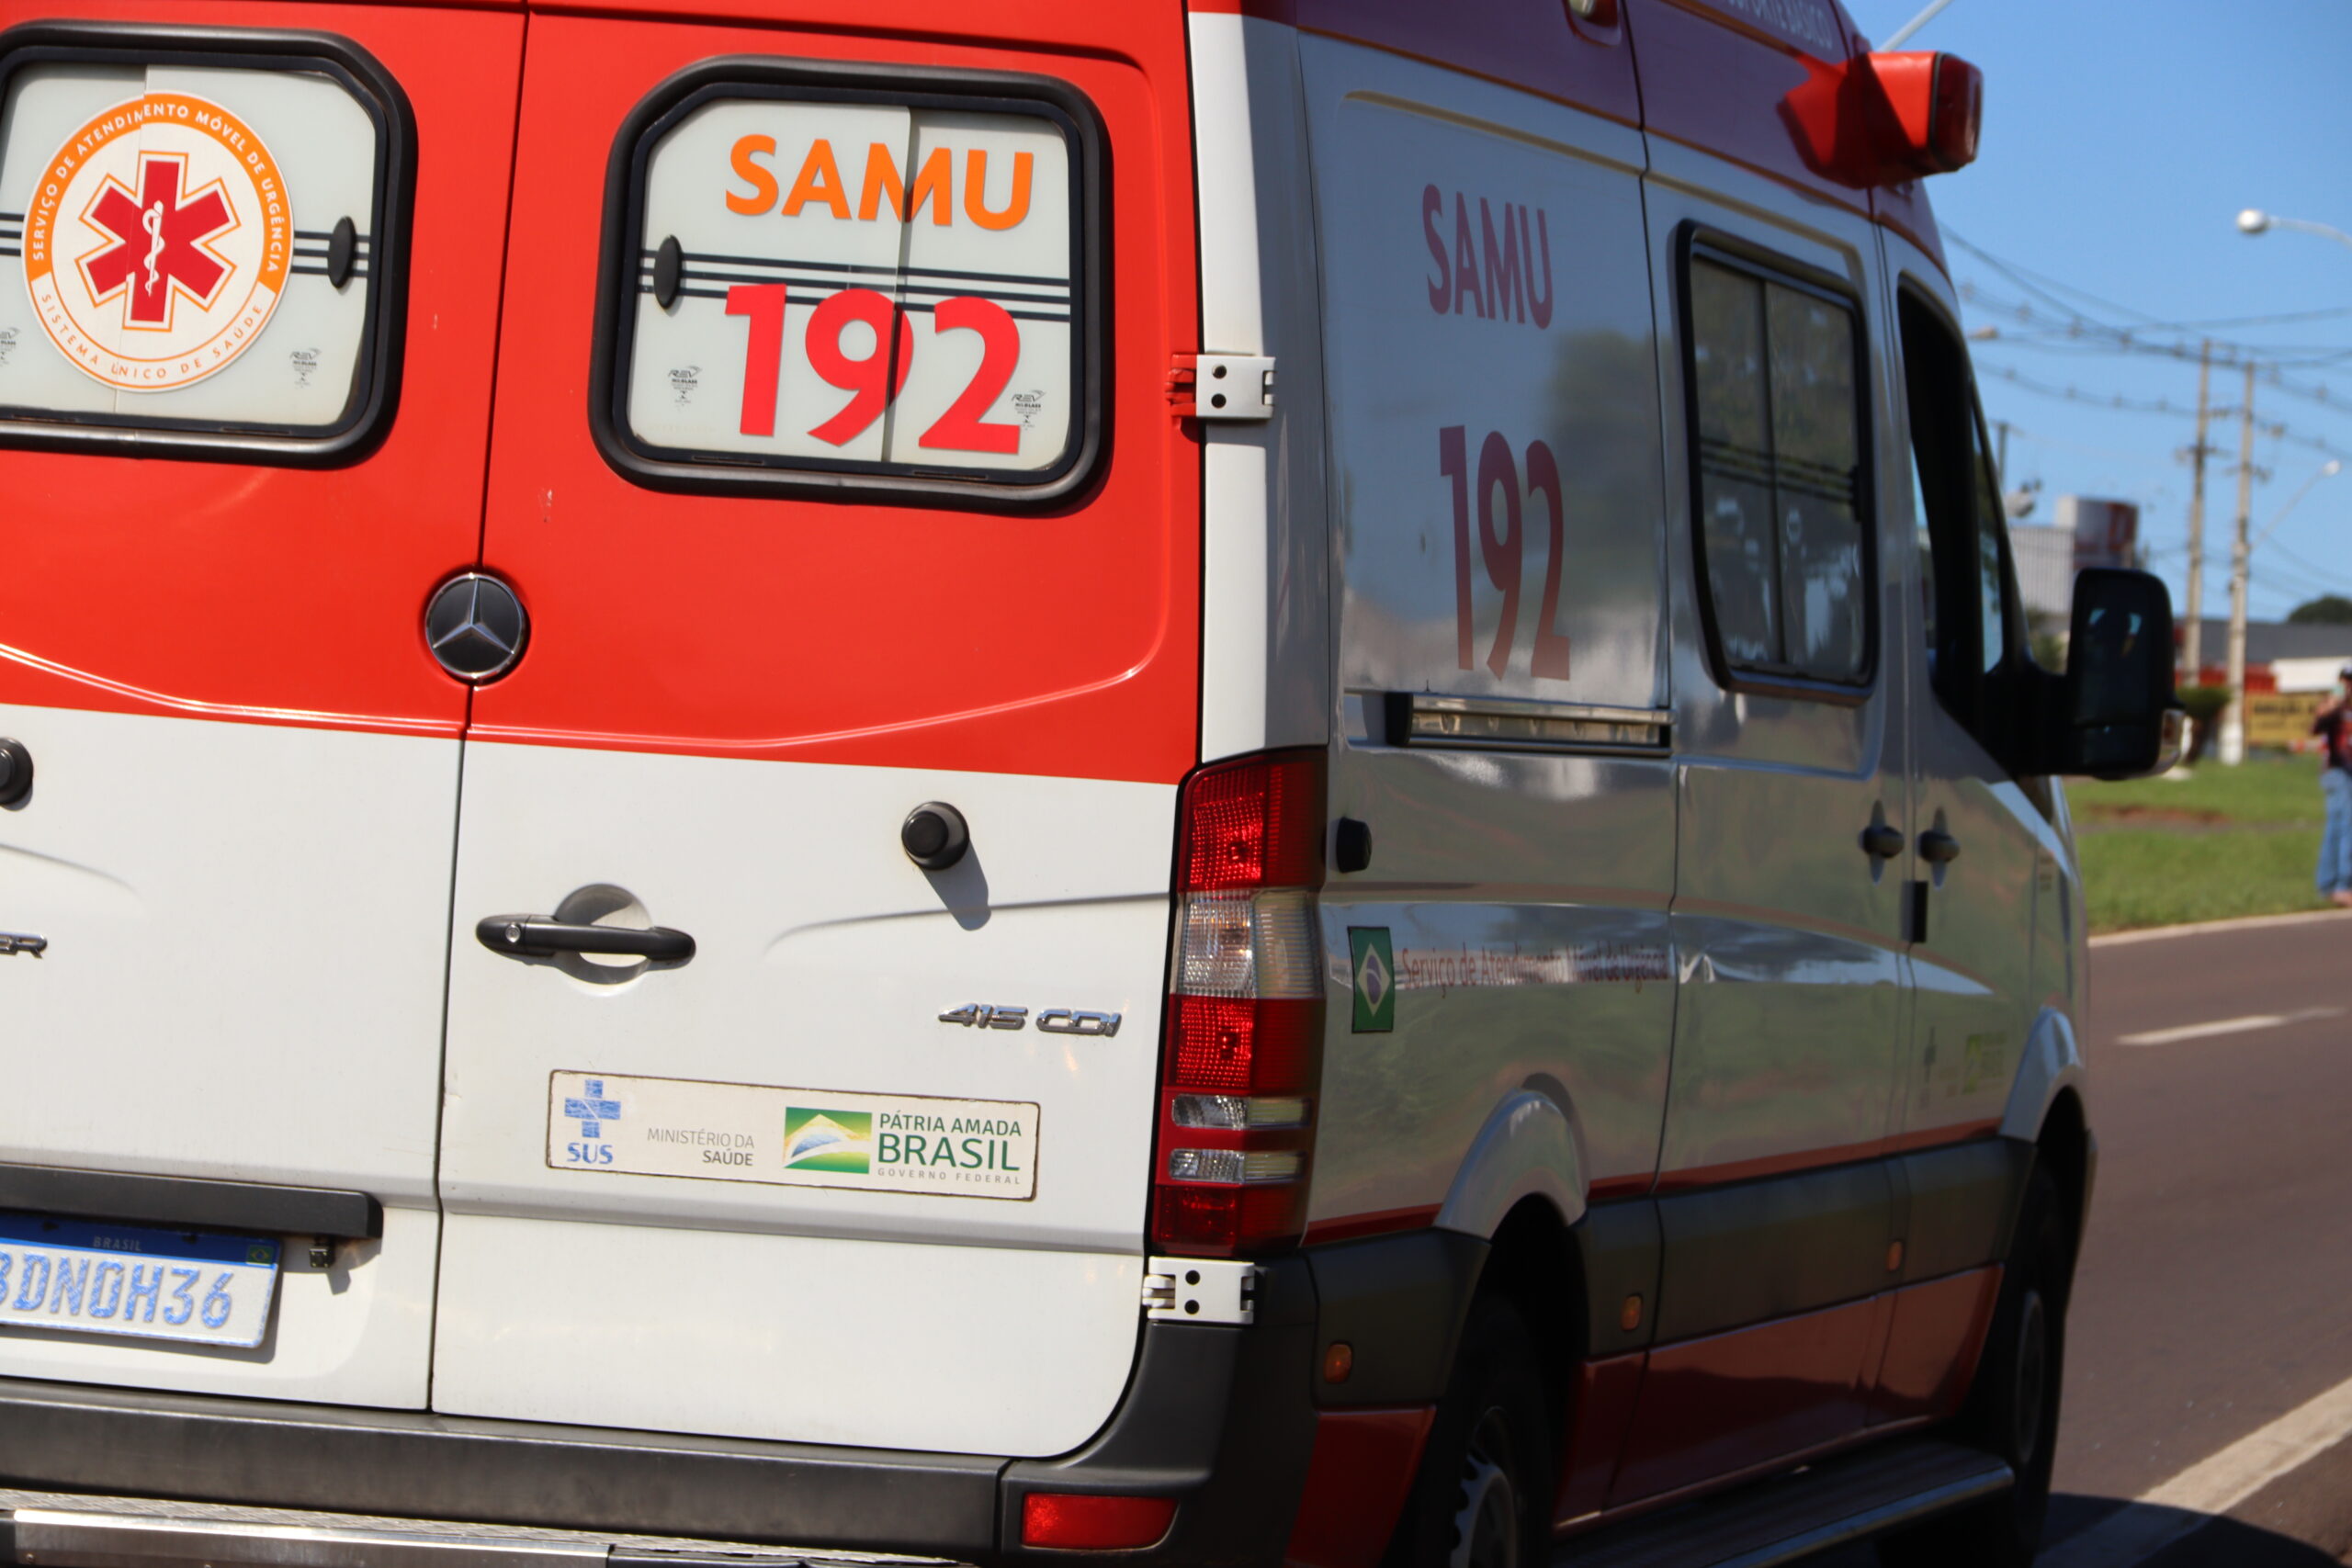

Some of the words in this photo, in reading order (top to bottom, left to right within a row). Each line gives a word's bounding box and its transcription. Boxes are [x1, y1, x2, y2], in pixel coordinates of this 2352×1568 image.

[33, 184, 58, 261] SERVIÇO
[56, 156, 74, 179] DE
[76, 102, 189, 157] ATENDIMENTO
[195, 109, 246, 152] MÓVEL
[246, 151, 266, 175] DE
[725, 133, 1035, 231] SAMU
[1422, 183, 1554, 330] SAMU
[41, 293, 99, 365] SISTEMA
[180, 357, 202, 374] DE
[212, 304, 263, 357] SAÚDE
[724, 283, 1022, 455] 192
[1439, 425, 1570, 682] 192
[1401, 947, 1455, 998] Serviço
[1462, 941, 1476, 987] de
[938, 1003, 1028, 1031] 415
[1035, 1009, 1122, 1038] CDI
[647, 1128, 731, 1146] MINISTÉRIO
[735, 1134, 755, 1148] DA
[879, 1110, 946, 1134] PÁTRIA
[950, 1118, 1022, 1137] AMADA
[567, 1142, 614, 1164] SUS
[702, 1148, 753, 1166] SAÚDE
[877, 1133, 1021, 1171] BRASIL
[877, 1168, 947, 1180] GOVERNO
[956, 1173, 1021, 1185] FEDERAL
[94, 1236, 142, 1251] BRASIL
